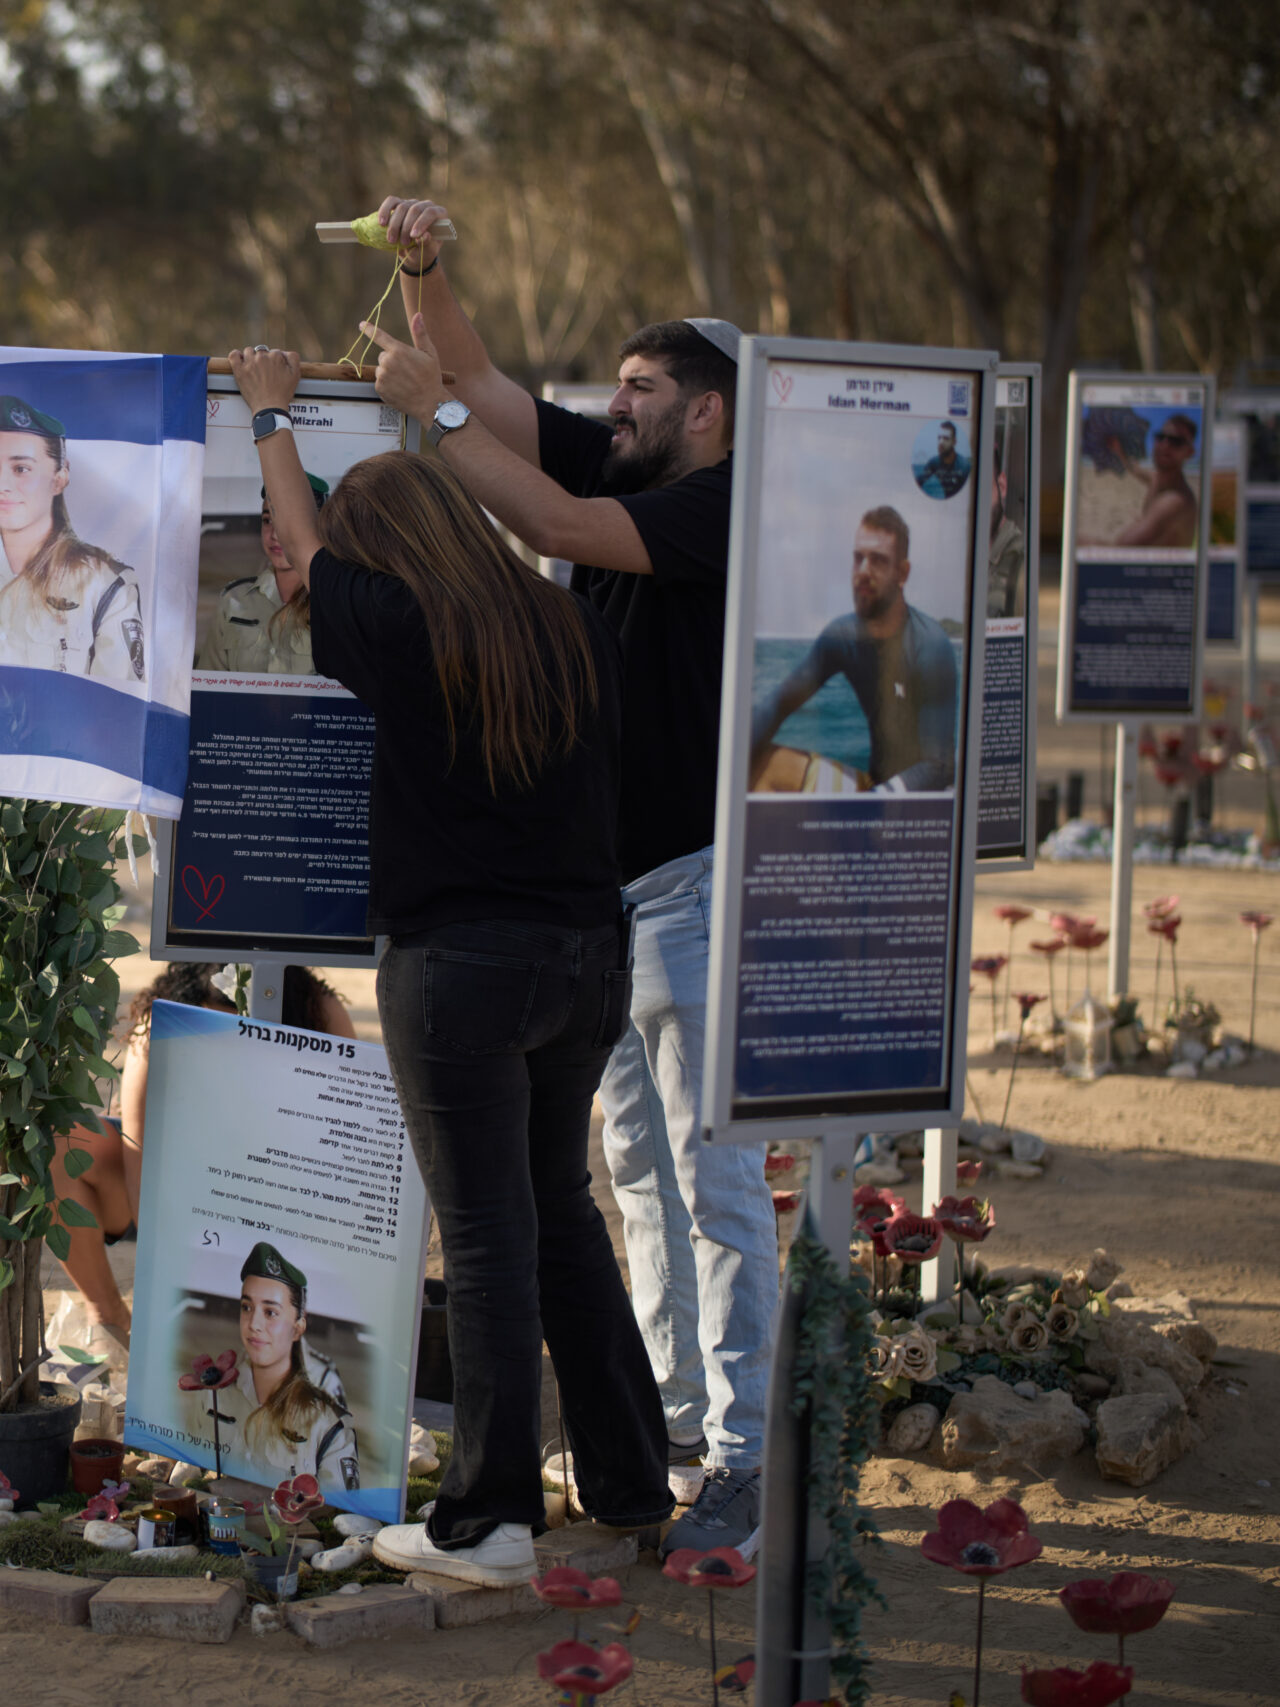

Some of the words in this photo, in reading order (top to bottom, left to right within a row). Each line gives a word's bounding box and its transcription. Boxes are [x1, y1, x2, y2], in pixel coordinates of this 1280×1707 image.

[846, 378, 870, 390] הרמן
[873, 379, 895, 393] עידן
[828, 394, 856, 409] Idan
[860, 397, 910, 412] Herman
[309, 405, 319, 413] רז
[292, 416, 333, 427] Mizrahi
[326, 861, 339, 869] ברזל
[238, 1020, 271, 1041] ברזל
[274, 1031, 332, 1054] מסקנות
[337, 1044, 355, 1058] 15
[372, 1072, 386, 1080] מבלי
[346, 1099, 362, 1108] להיות
[324, 1117, 340, 1125] להגיד
[342, 1121, 360, 1129] ללמוד
[371, 1160, 384, 1169] לתת
[385, 1163, 393, 1171] לא
[335, 1196, 350, 1204] ללכת
[366, 1225, 382, 1234] לדעת
[329, 1240, 344, 1249] סדנה
[347, 1245, 359, 1253] מתוך
[361, 1247, 367, 1256] רז
[368, 1249, 376, 1257] של
[148, 1424, 172, 1440] מזרחי
[176, 1432, 184, 1442] רז
[188, 1433, 200, 1445] של
